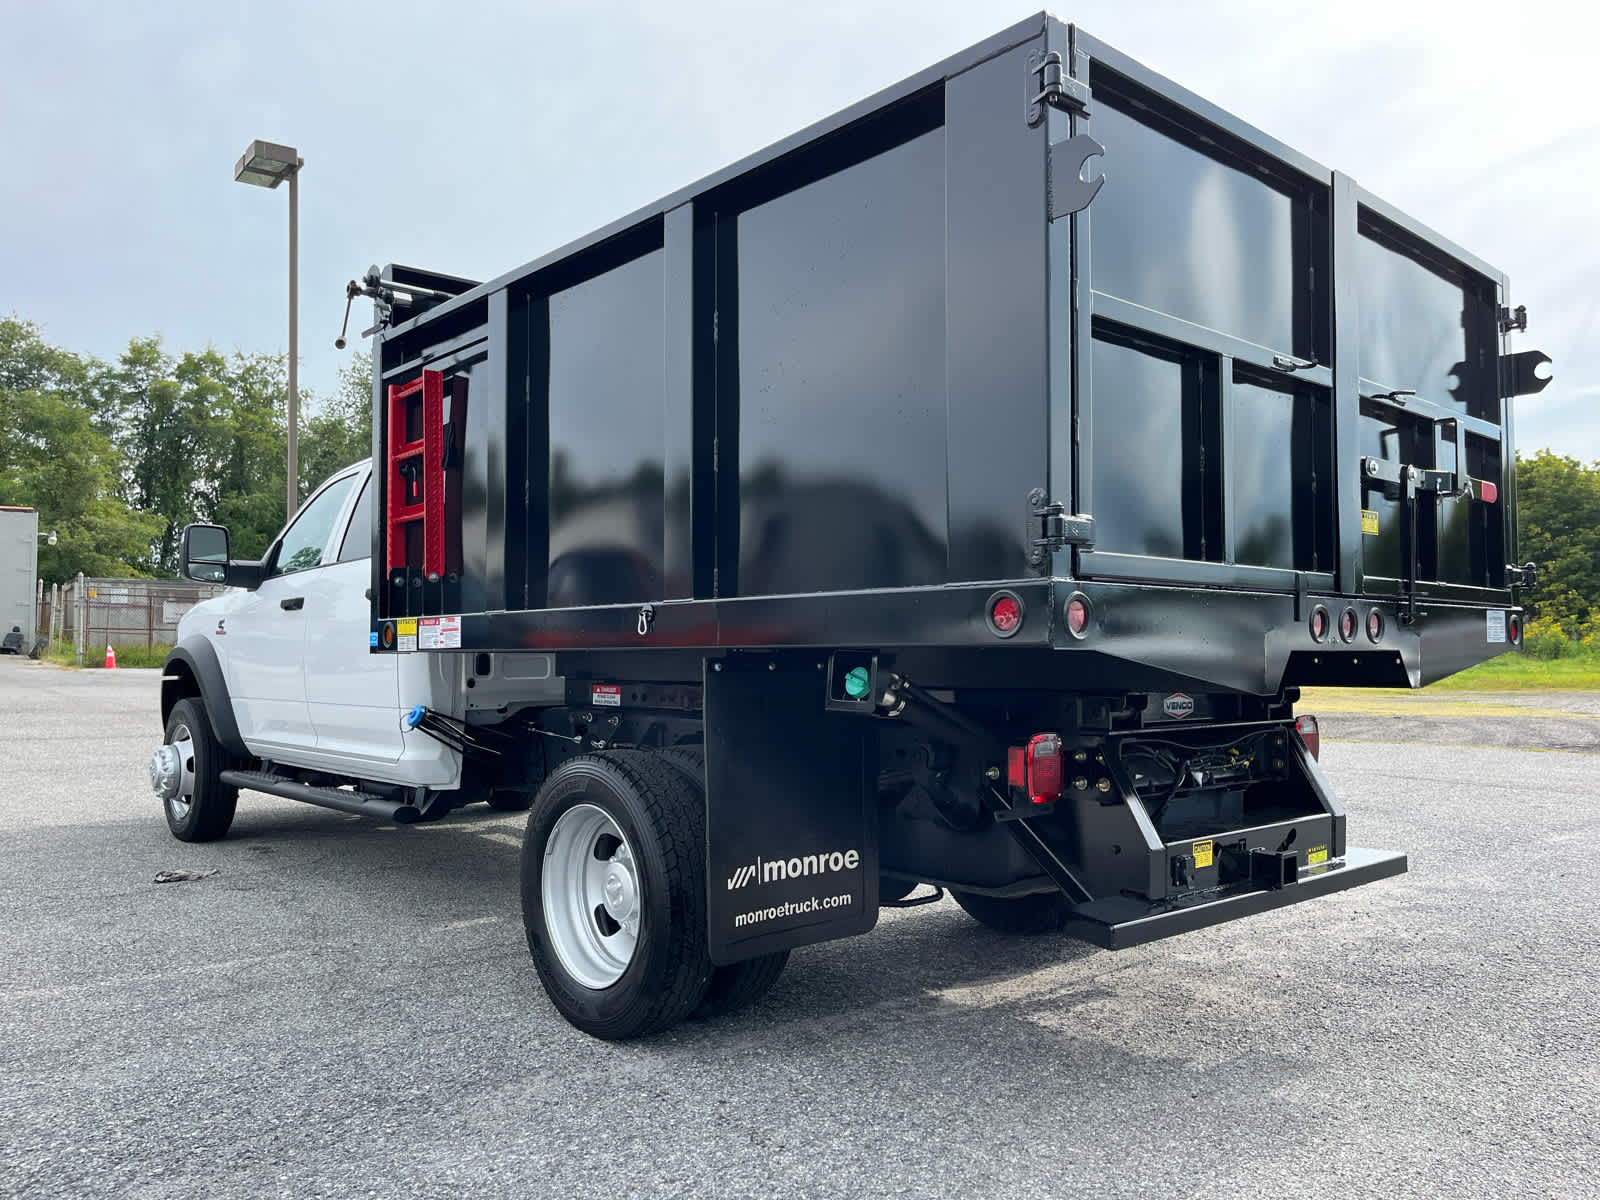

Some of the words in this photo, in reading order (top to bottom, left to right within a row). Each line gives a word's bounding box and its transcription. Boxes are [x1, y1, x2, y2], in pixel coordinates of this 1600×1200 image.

[1167, 702, 1192, 710] VENCO
[764, 850, 859, 882] monroe
[735, 894, 851, 927] monroetruck.com
